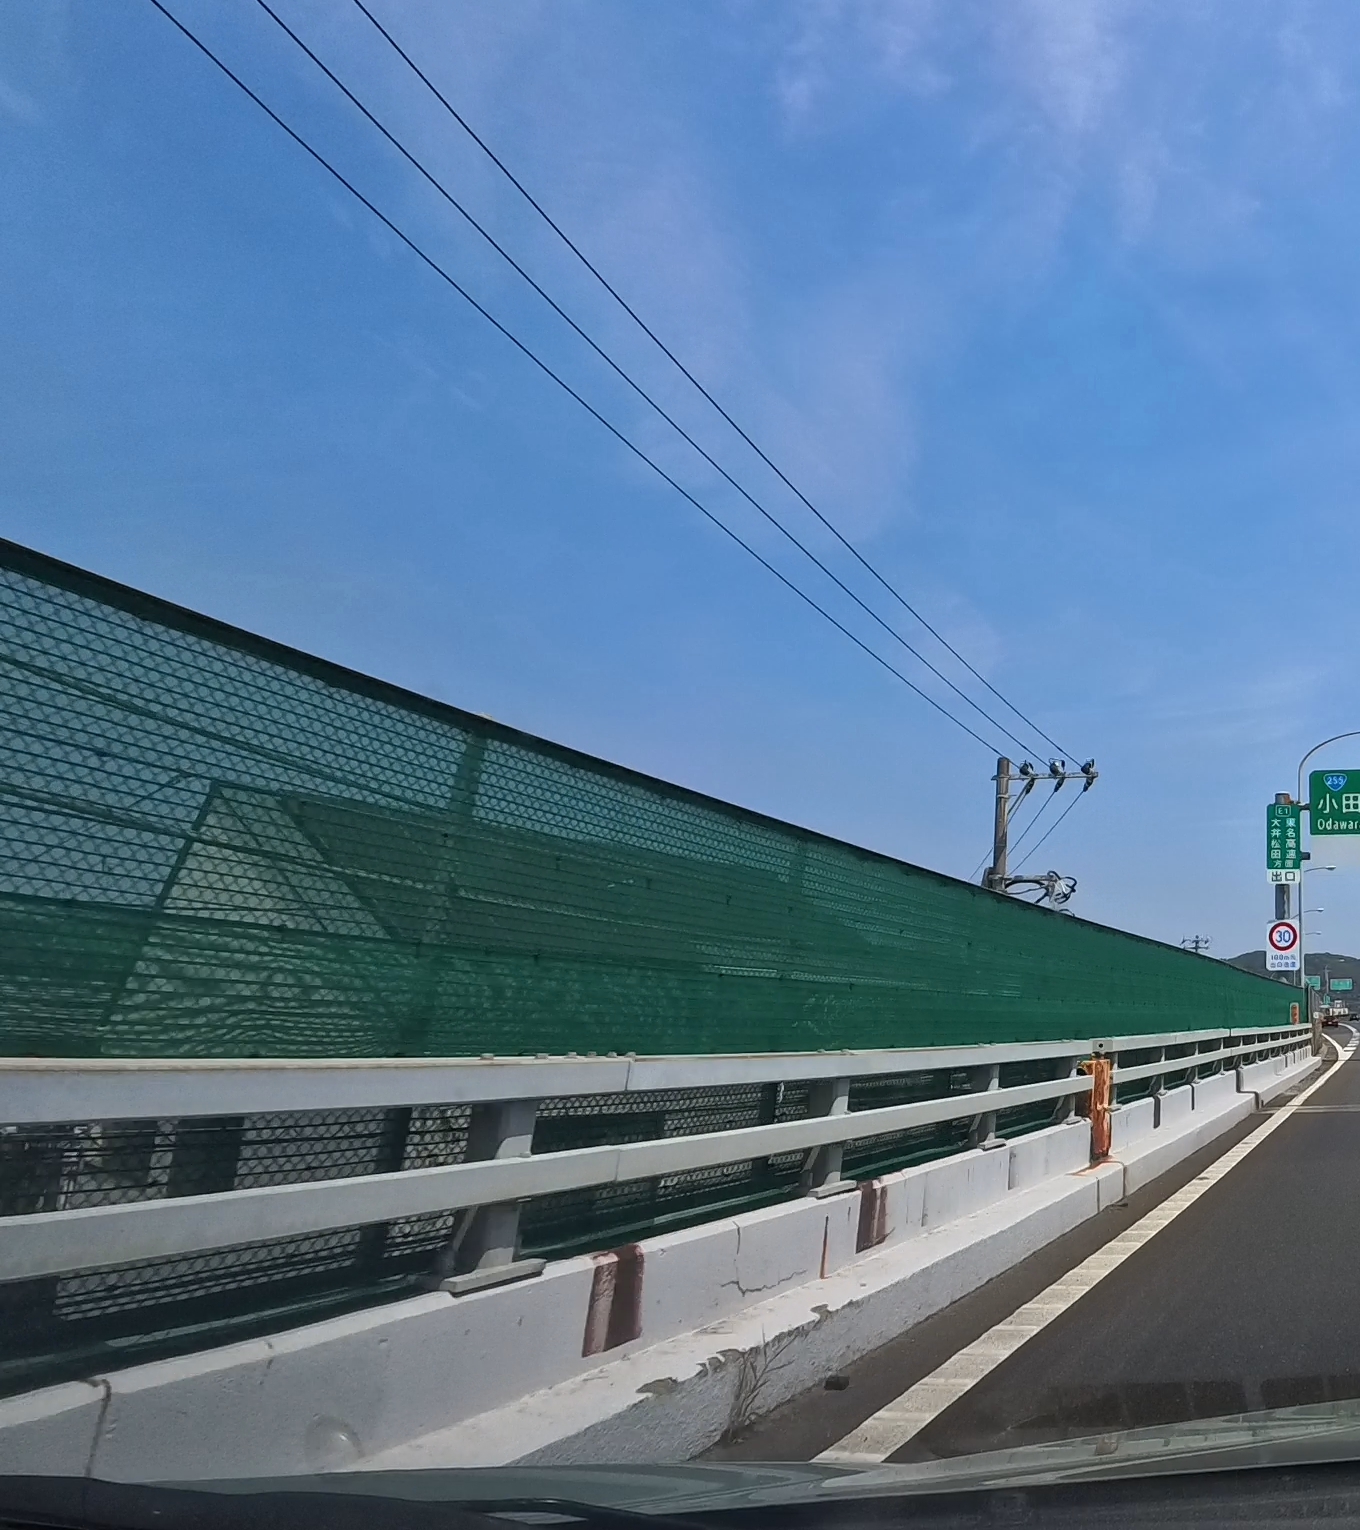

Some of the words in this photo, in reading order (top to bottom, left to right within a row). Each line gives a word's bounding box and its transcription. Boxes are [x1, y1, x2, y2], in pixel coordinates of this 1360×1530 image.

[1326, 776, 1344, 785] 255
[1278, 807, 1289, 815] E1
[1271, 871, 1296, 882] 出口
[1275, 930, 1291, 943] 30
